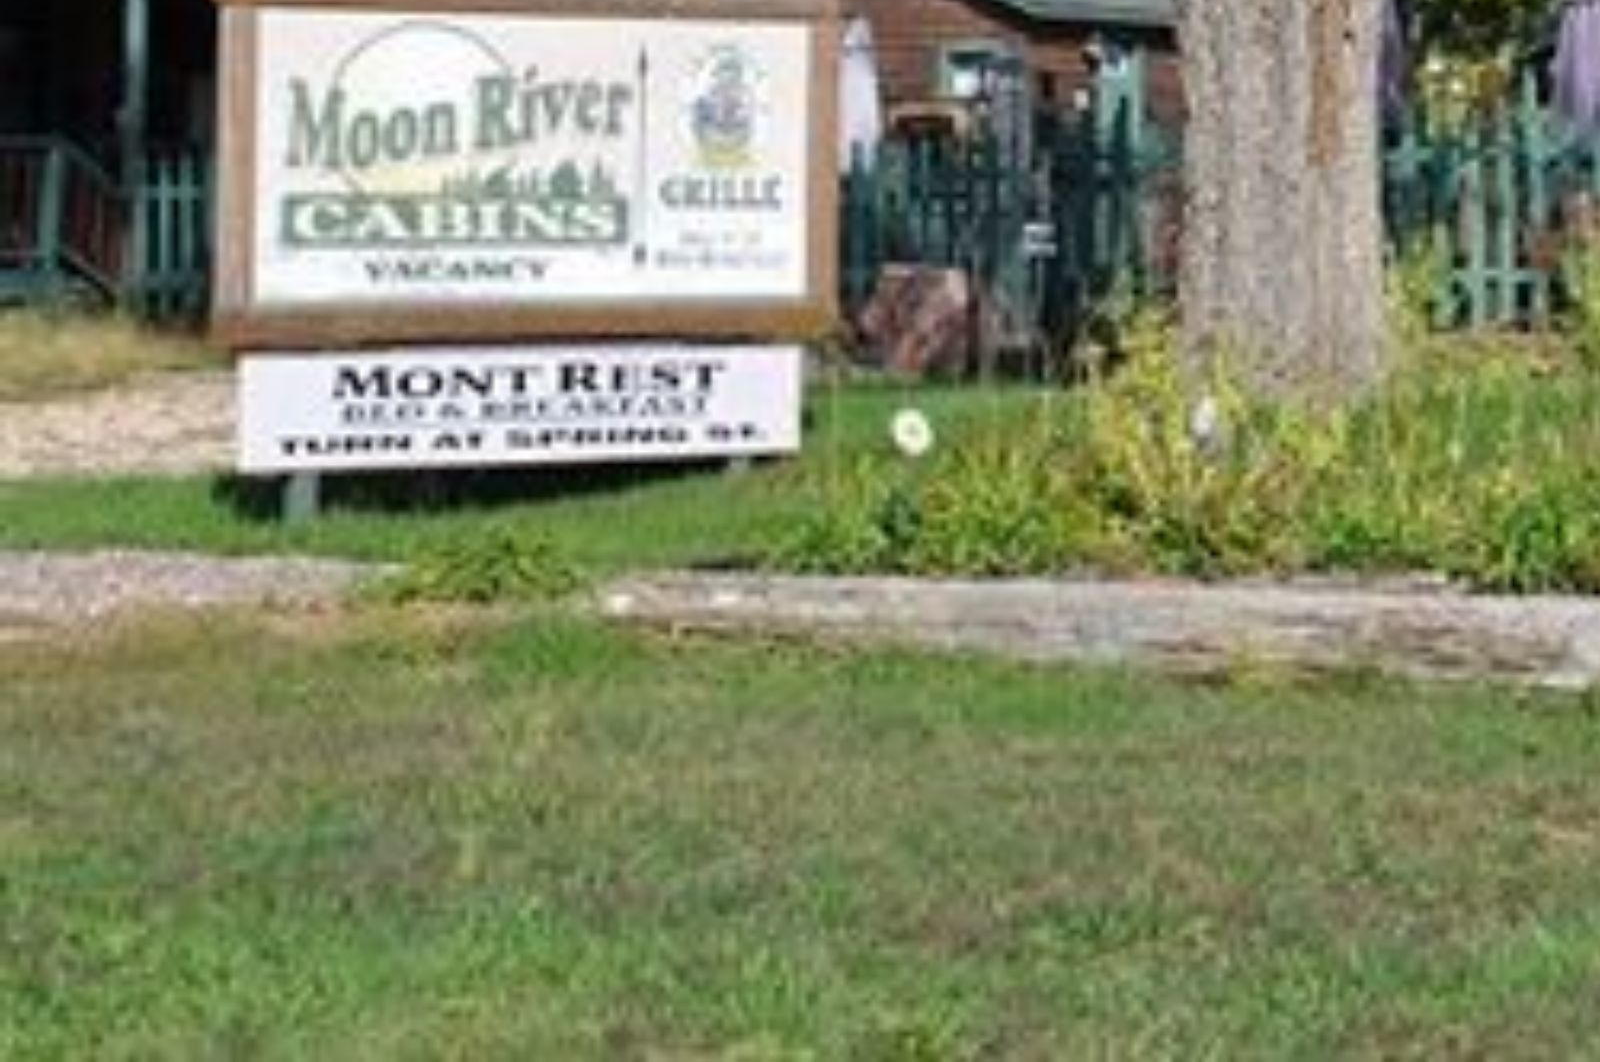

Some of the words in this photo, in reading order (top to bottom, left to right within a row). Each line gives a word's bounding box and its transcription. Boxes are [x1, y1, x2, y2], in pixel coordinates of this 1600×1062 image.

[286, 77, 458, 167] Moon
[474, 64, 632, 148] River
[293, 200, 617, 240] CABINS
[363, 256, 550, 282] VACANCY
[332, 363, 544, 399] MONT
[556, 359, 728, 393] REST
[278, 434, 412, 456] TURN
[431, 429, 484, 451] AT
[504, 427, 688, 449] SPRING
